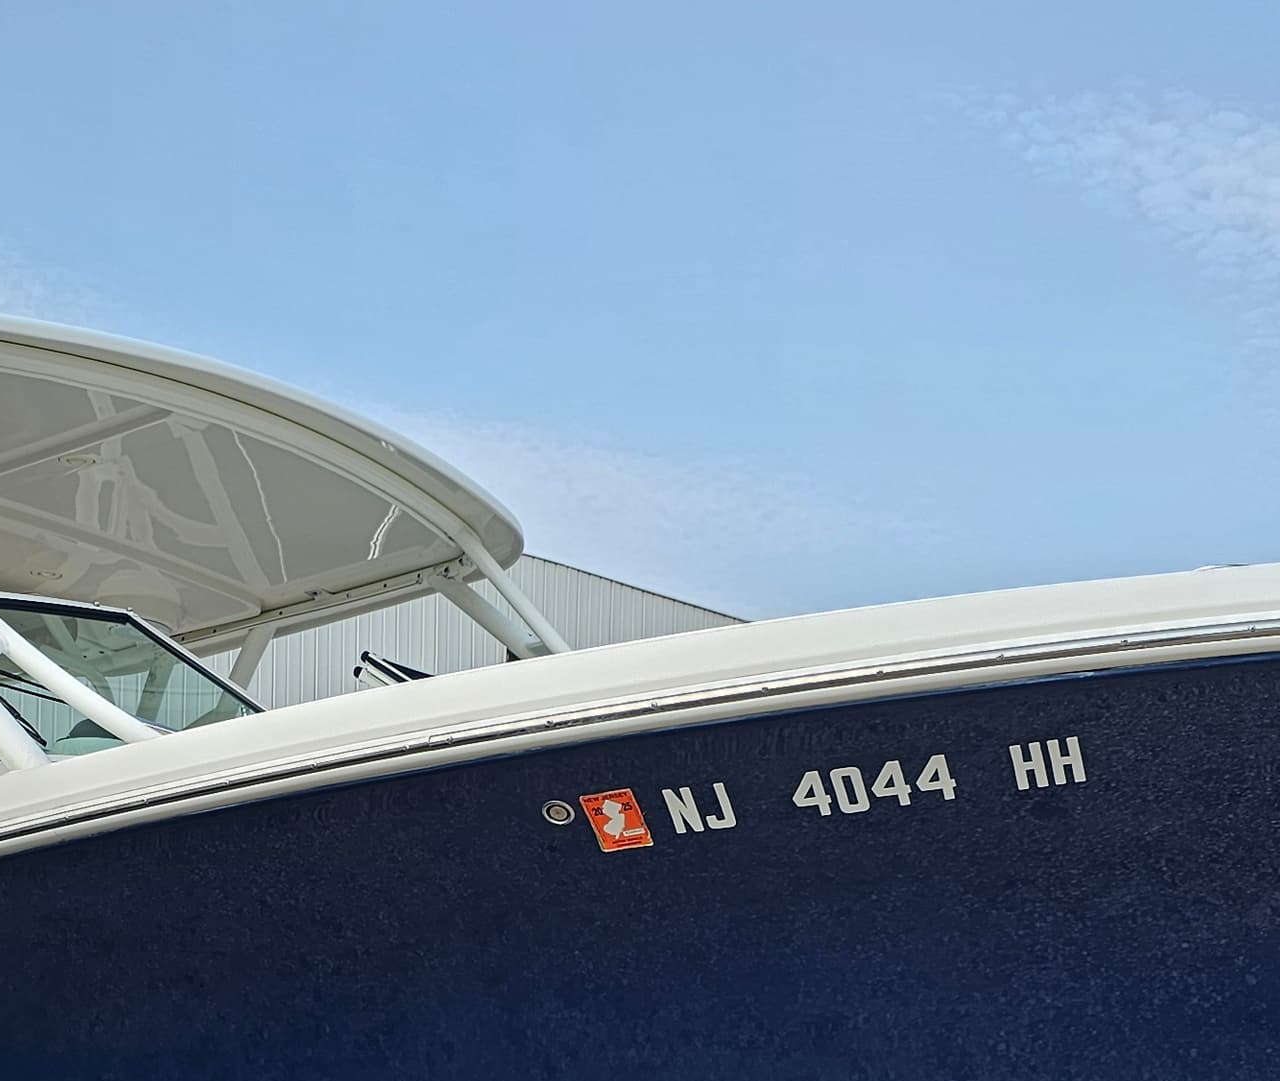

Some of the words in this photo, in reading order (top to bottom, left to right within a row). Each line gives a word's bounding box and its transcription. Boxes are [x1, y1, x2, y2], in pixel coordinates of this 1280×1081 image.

[661, 782, 737, 834] NJ
[792, 754, 957, 816] 4044
[1009, 736, 1086, 790] HH
